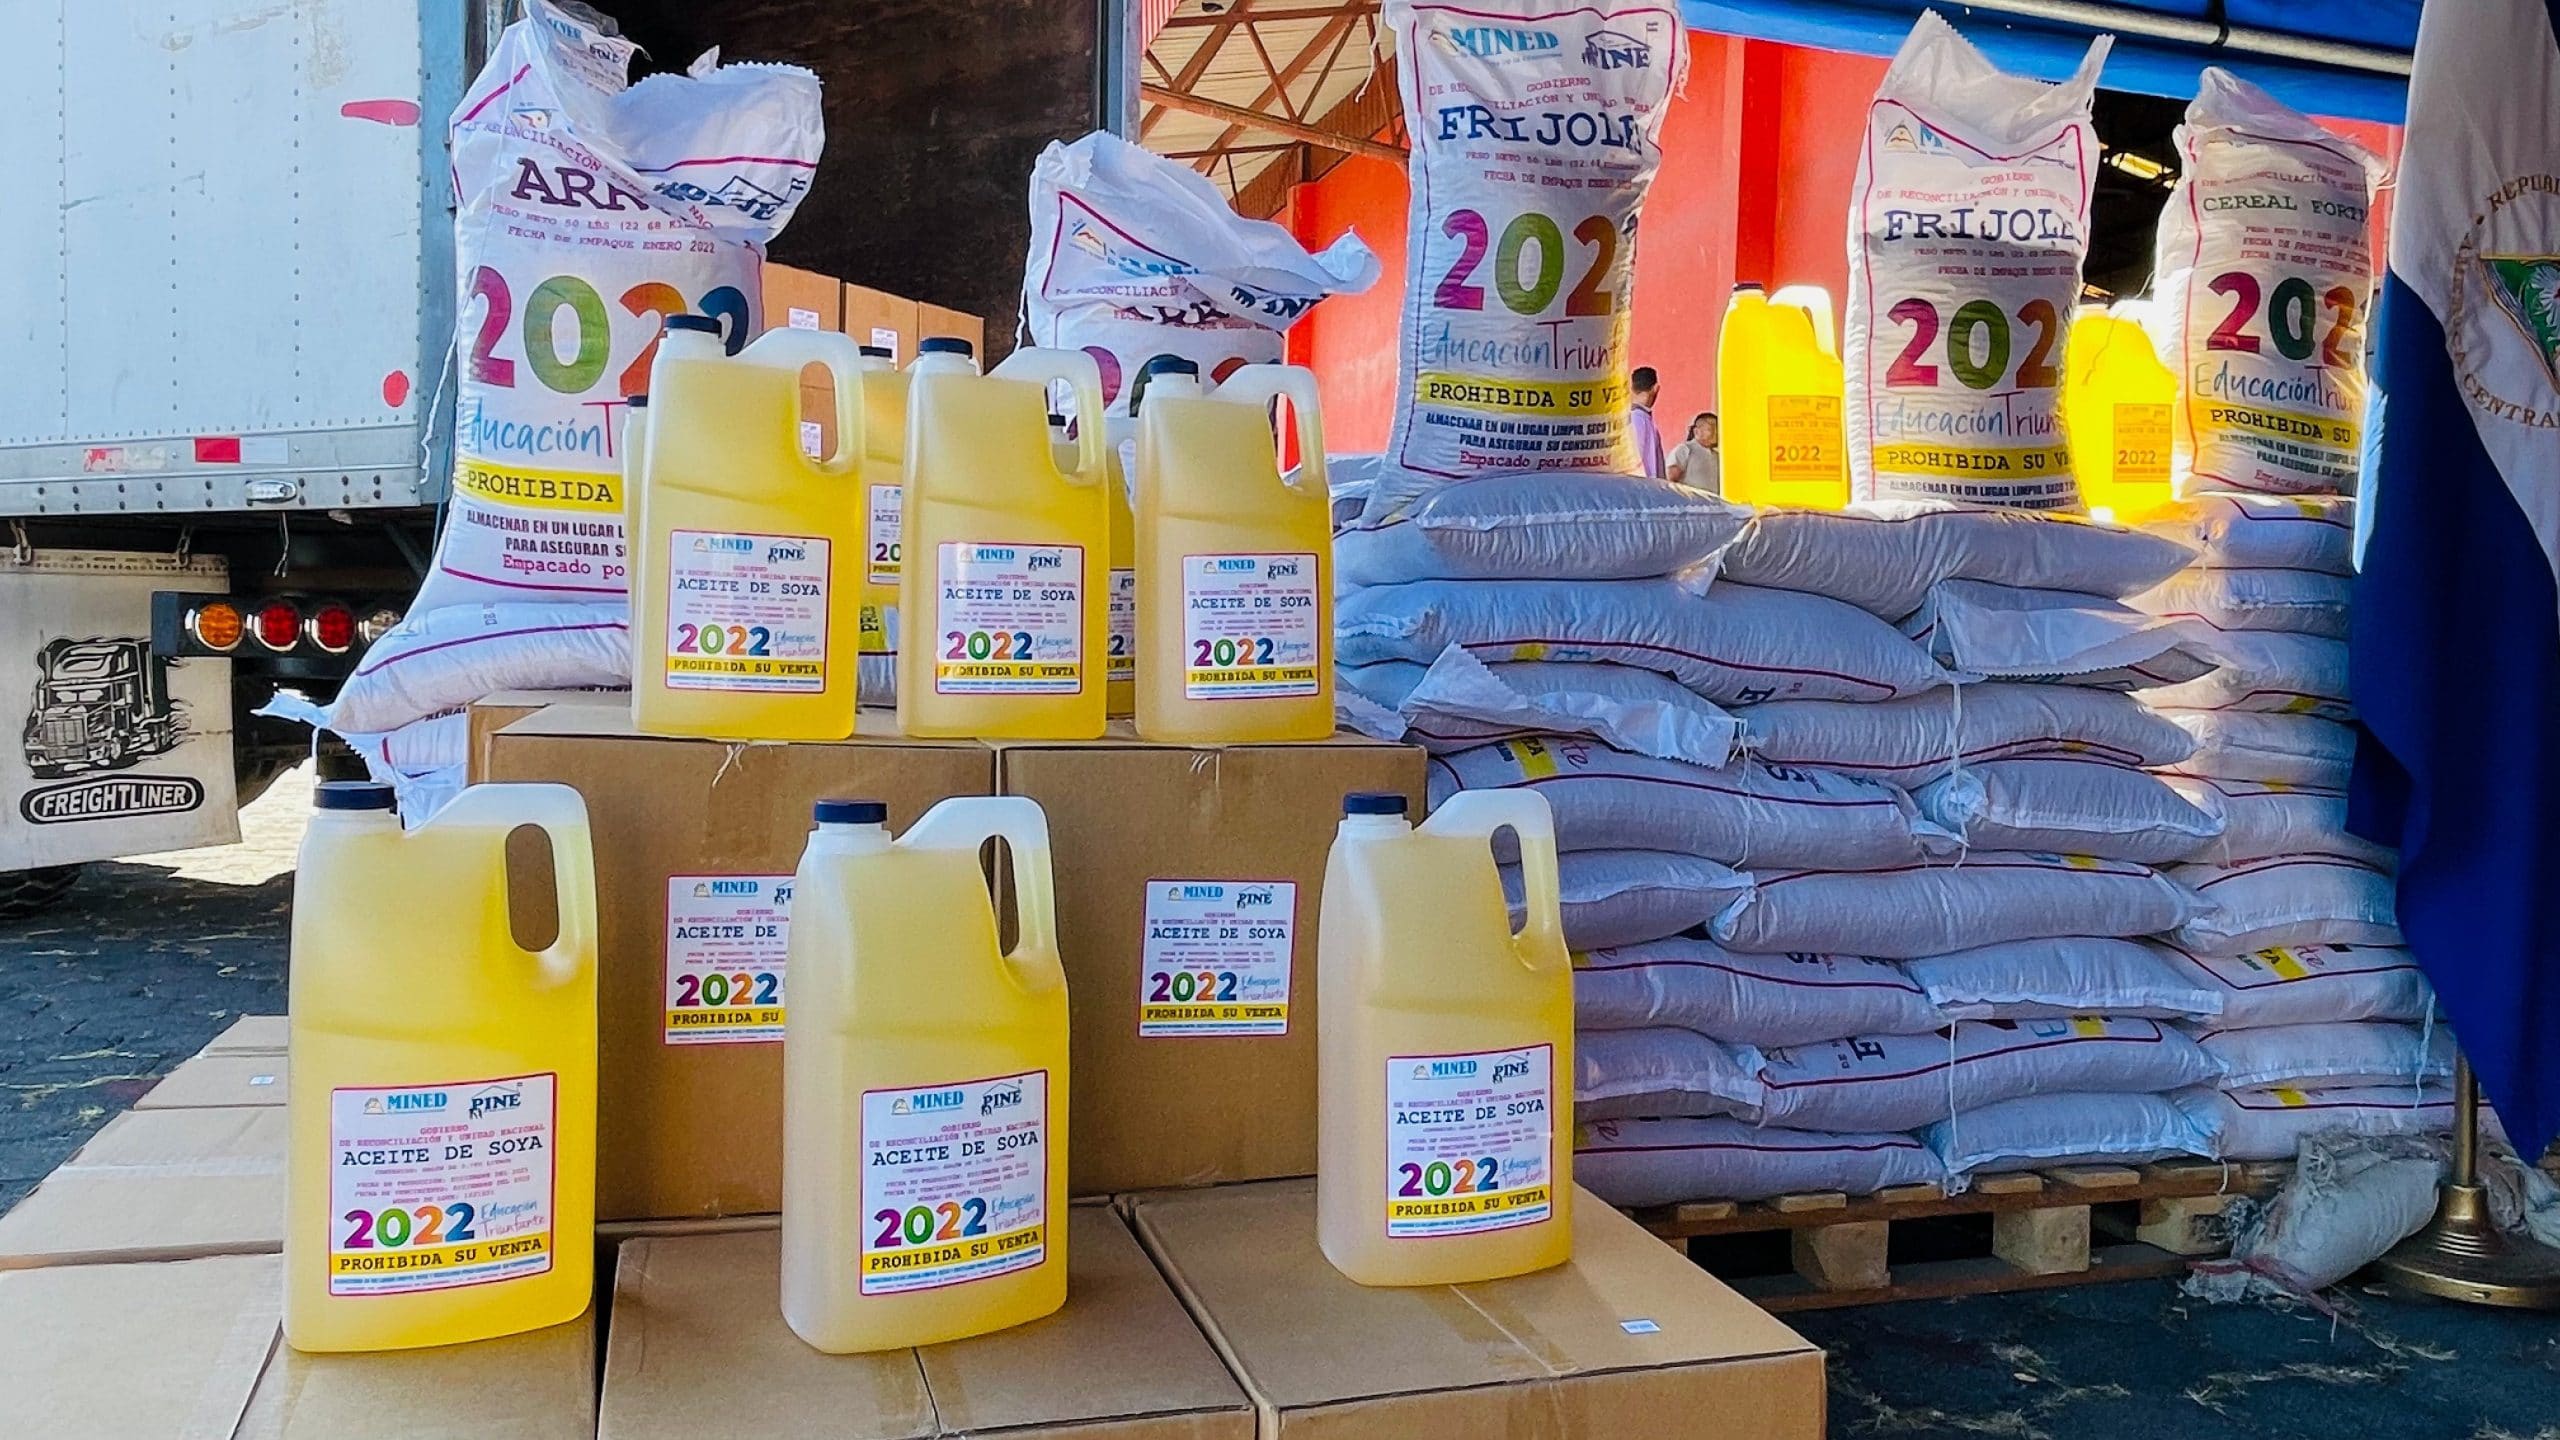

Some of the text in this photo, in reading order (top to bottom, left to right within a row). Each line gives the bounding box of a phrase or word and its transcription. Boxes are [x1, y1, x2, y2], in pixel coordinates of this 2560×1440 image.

[1526, 77, 1592, 92] GOBIERNO
[2203, 194, 2298, 212] CEREAL
[526, 213, 557, 225] NETO
[565, 219, 579, 228] 50
[588, 220, 610, 230] LBS
[507, 225, 716, 254] FECHA DE EMPAQUE ENERO 2022
[1421, 320, 1550, 368] Educación
[2194, 359, 2317, 405] Educación
[1430, 382, 1593, 408] PROHIBIDA SU
[2464, 373, 2560, 428] CENTRA
[1426, 412, 1549, 437] ALMACENAR EN UN LUGAR
[1875, 396, 2003, 440] Educación
[2211, 408, 2350, 443] PROHIBIDA SU
[1459, 433, 1559, 451] PARA ASEGURAR SU
[1775, 445, 1821, 462] 2022
[1459, 450, 1530, 469] Empacado
[1888, 450, 2045, 471] PROHIBIDA SU
[2118, 449, 2156, 465] 2022
[467, 470, 614, 503] PROHIBIDA
[1950, 484, 1963, 496] EN
[467, 510, 614, 538] ALMACENAR EN UN LUGAR
[506, 537, 609, 557] PARA ASEGURAR
[710, 538, 805, 562] MINED PINE
[502, 554, 592, 577] Empacado
[976, 549, 1062, 570] MINED PINE
[1218, 559, 1298, 580] MINED PINE
[677, 578, 820, 596] ACEITE DE SOYA
[945, 588, 1075, 601] ACEITE DE SOYA
[1192, 597, 1312, 609] ACEITE DE SOYA
[677, 623, 770, 656] 2022
[946, 631, 1033, 660] 2022
[1194, 638, 1274, 666] 2022
[674, 660, 818, 674] PROHIBIDA SU VENTA
[943, 666, 1075, 676] POHIBIDA SU VENTA
[1192, 670, 1314, 682] PROHIBIDA SU VENTA
[42, 783, 187, 818] FREIGHTLINER
[712, 881, 758, 894] MINED
[1184, 886, 1273, 909] MINED PINE
[676, 926, 777, 938] ACEITE DE
[1152, 928, 1286, 939] ACEITE DE SOYA
[676, 973, 778, 1007] 2022
[1150, 972, 1237, 1002] 2022
[673, 1012, 779, 1024] PROHIBIDA SU
[1147, 1008, 1282, 1018] PROHIBIDA SU VENTA
[1432, 1061, 1529, 1083] MINED PINE
[387, 1093, 521, 1118] MINED PINE
[912, 1090, 1022, 1115] MINED PINE
[1396, 1099, 1545, 1124] ACEITE DE SOYA
[339, 1139, 351, 1147] DE
[459, 1130, 495, 1141] UNIDAD
[500, 1124, 545, 1137] NACIONAL
[420, 1125, 468, 1135] GOBIERNO
[941, 1121, 981, 1132] GOBIERNO
[343, 1136, 543, 1165] ACEITE DE SOYA
[872, 1131, 1039, 1166] ACEITE DE SOYA
[1398, 1157, 1499, 1197] 2022
[1396, 1190, 1546, 1216] PROHIBIDA SU VENTA
[344, 1202, 475, 1249] 2022
[874, 1197, 987, 1248] 2022
[340, 1238, 542, 1271] PROHIBIDA SU VENTA
[871, 1231, 1039, 1270] PROHIBIDA SU VENTA
